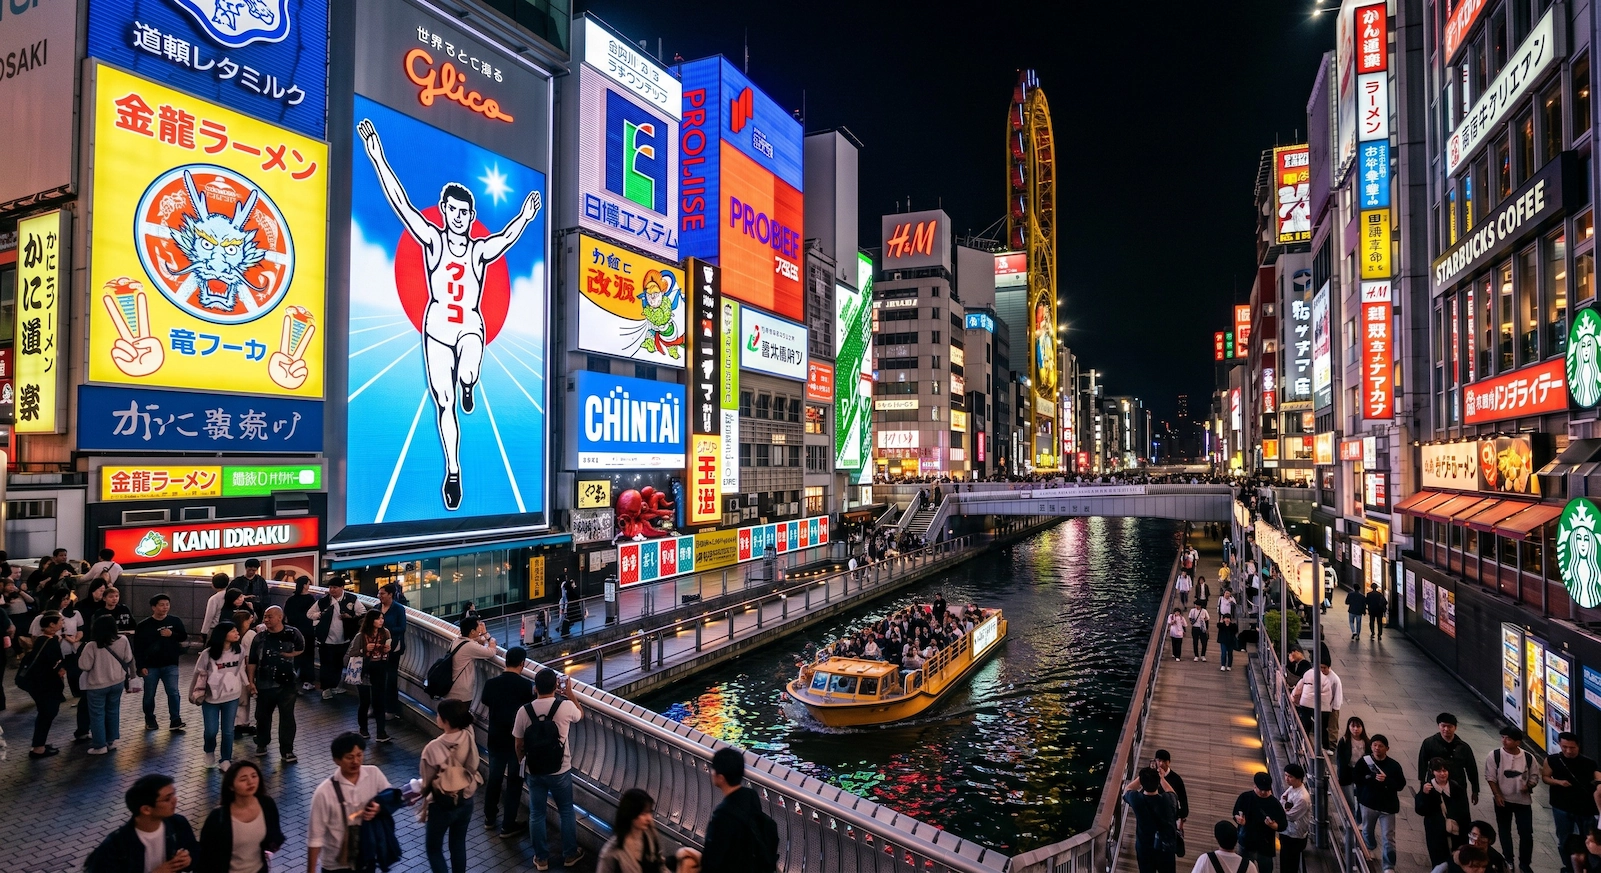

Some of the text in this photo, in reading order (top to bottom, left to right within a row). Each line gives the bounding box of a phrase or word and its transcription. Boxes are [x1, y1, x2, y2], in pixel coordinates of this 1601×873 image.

[404, 48, 514, 123] Glico
[1366, 81, 1381, 134] ラーメン
[114, 92, 318, 181] 金龍ラーメン
[887, 220, 937, 258] H&M
[1436, 179, 1545, 287] STARBUCKS COFEE
[111, 470, 216, 493] 金龍ラーメン
[172, 529, 221, 553] KANI
